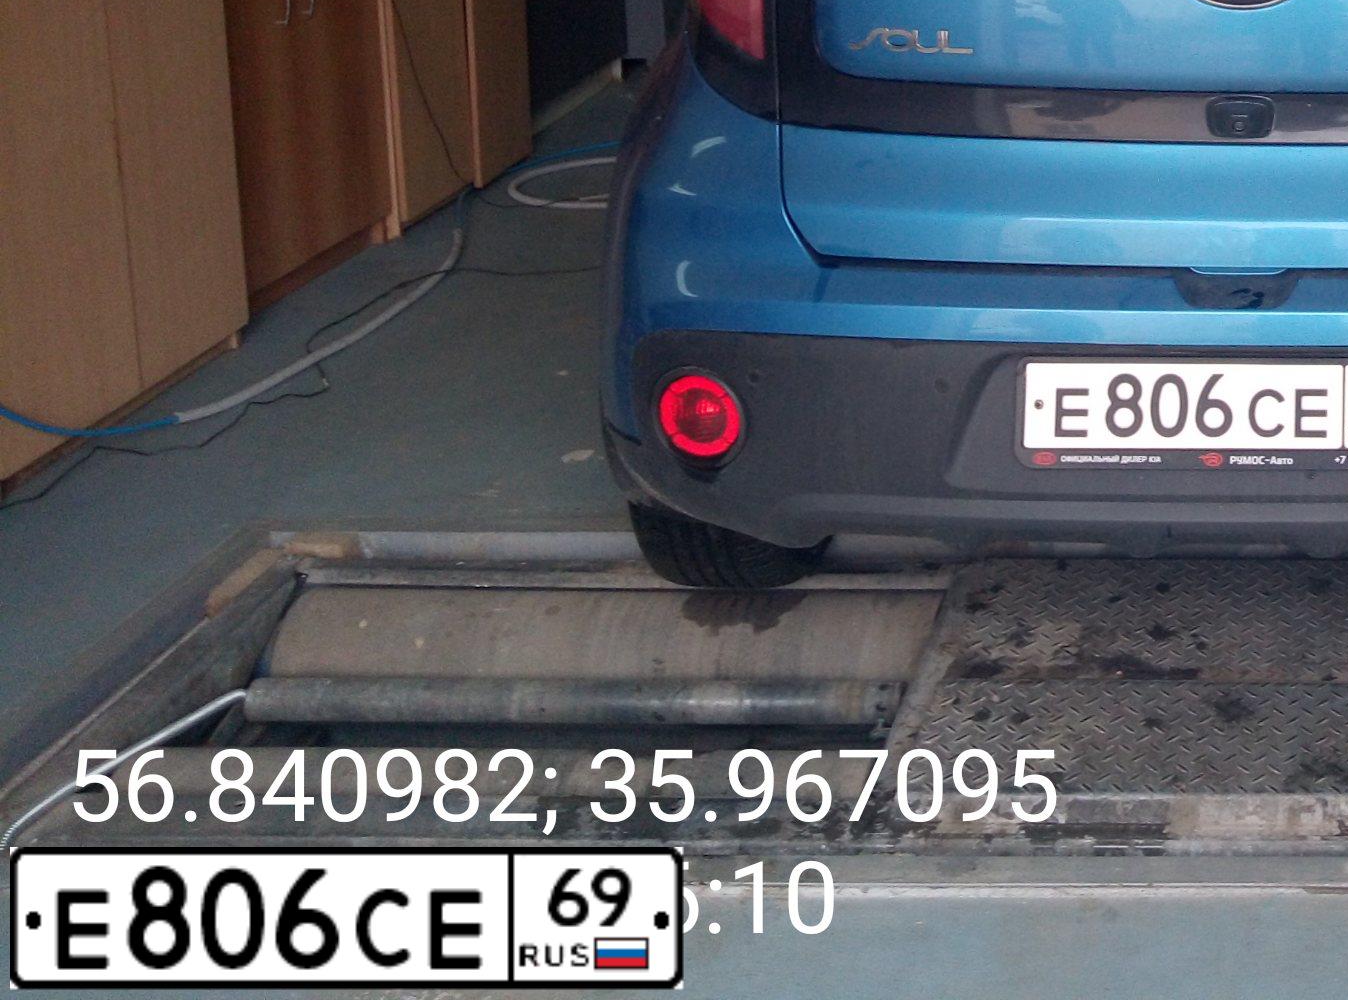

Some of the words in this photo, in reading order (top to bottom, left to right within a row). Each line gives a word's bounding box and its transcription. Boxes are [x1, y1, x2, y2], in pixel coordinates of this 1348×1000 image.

[849, 28, 974, 54] SOUL
[1054, 373, 1328, 438] Е806СЕ
[1120, 455, 1147, 465] ДИЛЕР
[1334, 456, 1347, 465] +7
